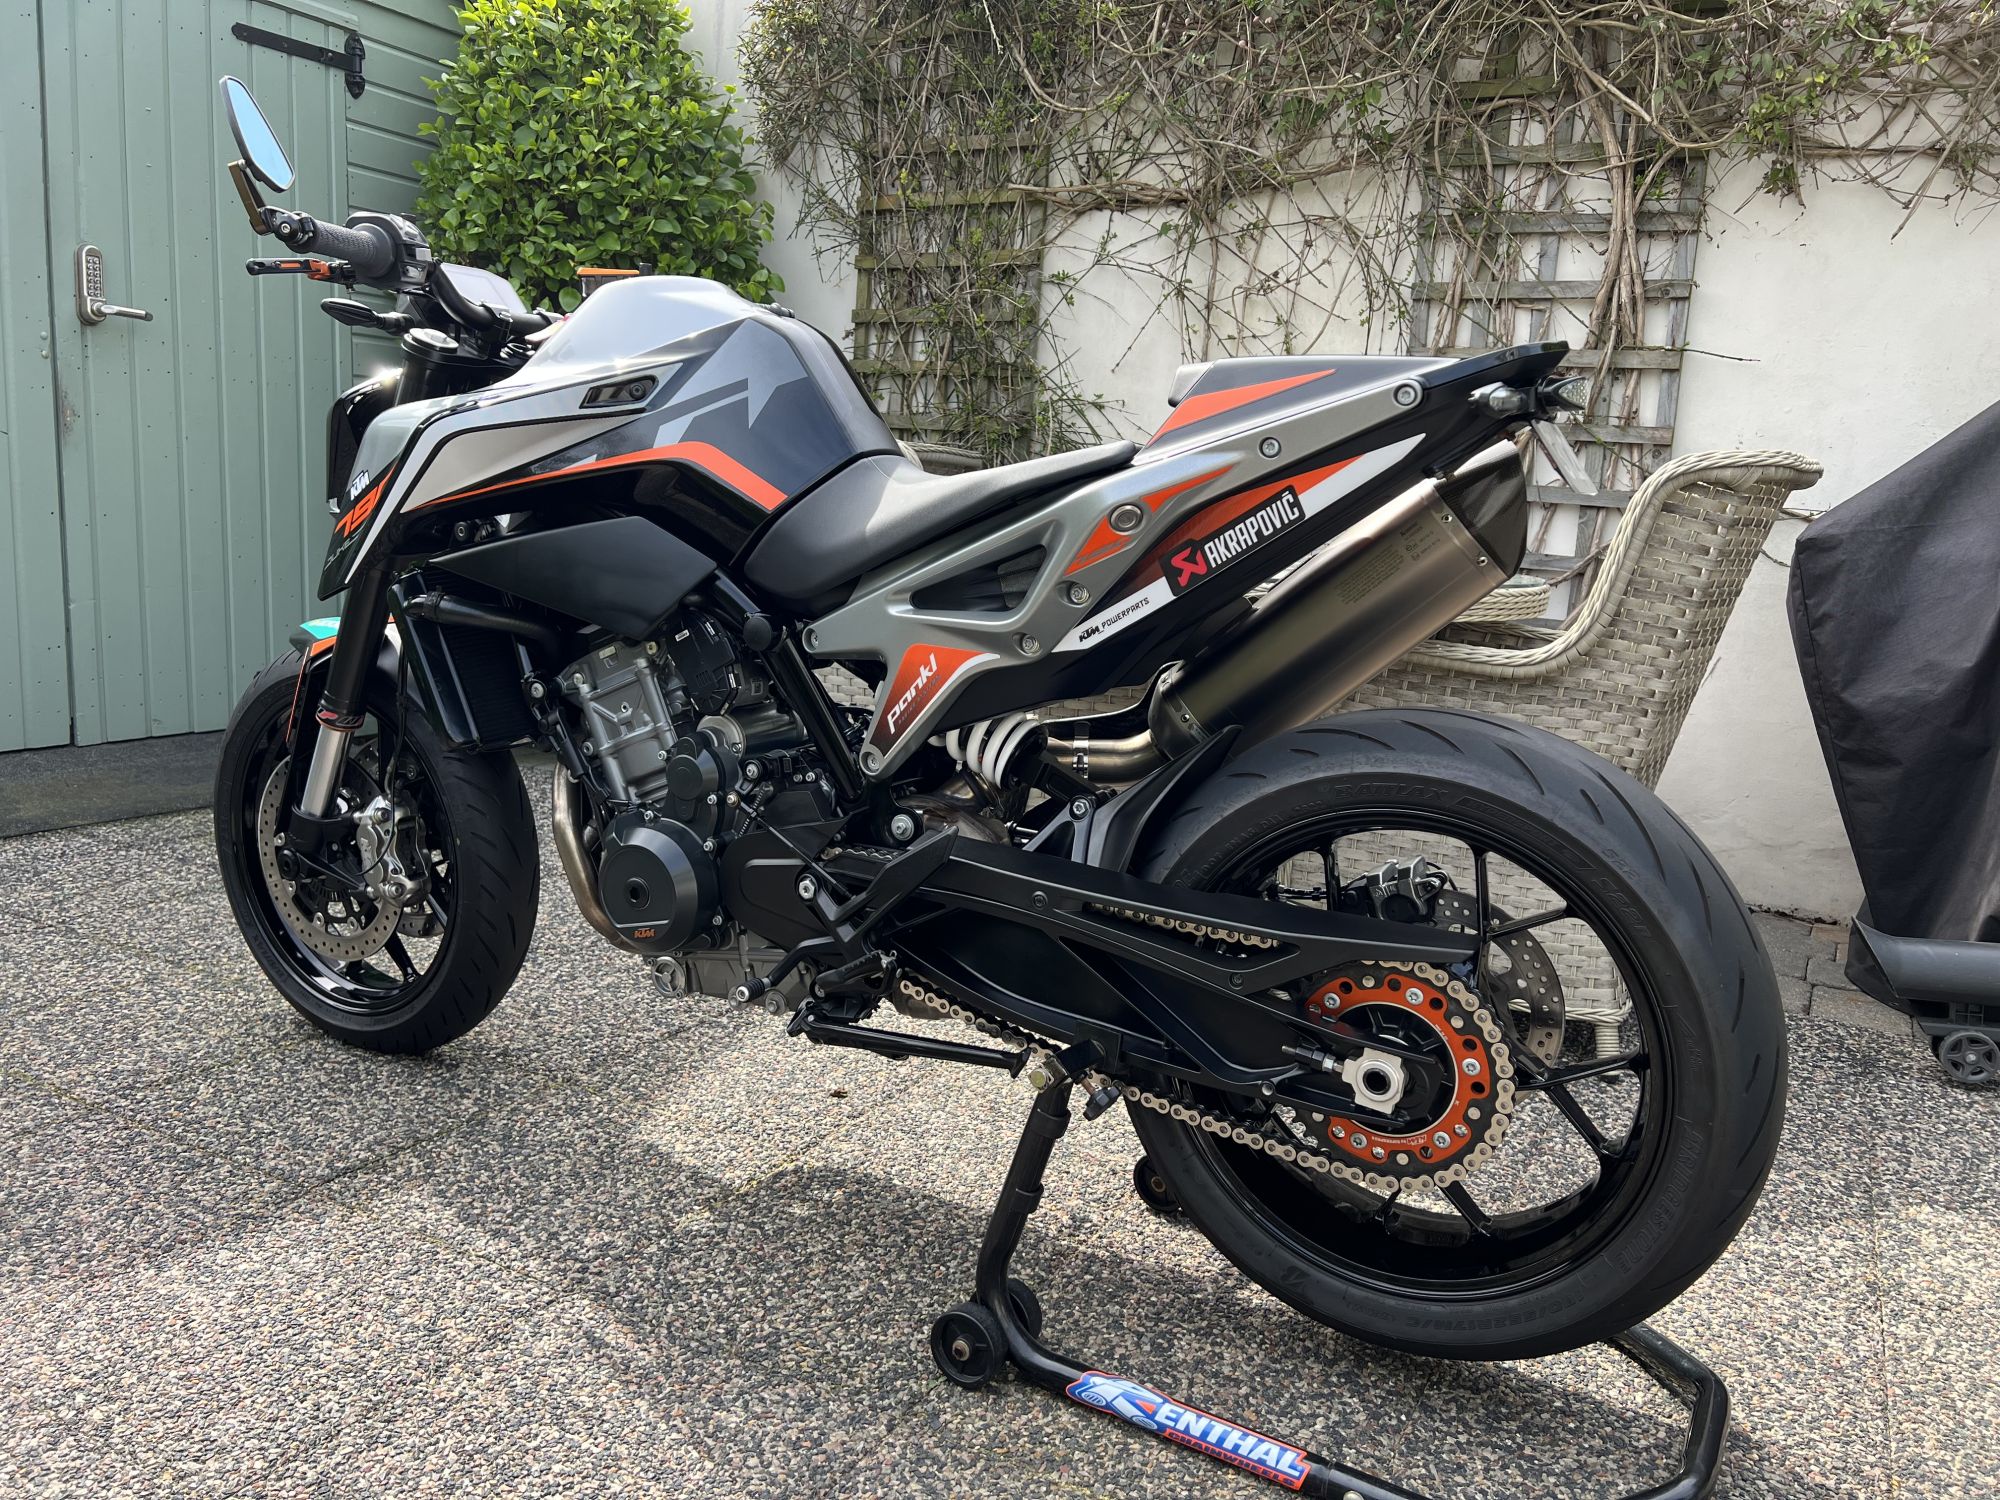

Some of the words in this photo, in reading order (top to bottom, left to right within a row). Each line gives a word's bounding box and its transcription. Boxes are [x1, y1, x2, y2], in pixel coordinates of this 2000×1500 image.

[350, 471, 370, 501] KTM
[1079, 624, 1100, 642] KTM
[1102, 597, 1150, 631] POWERPARTS
[633, 928, 657, 940] KTM
